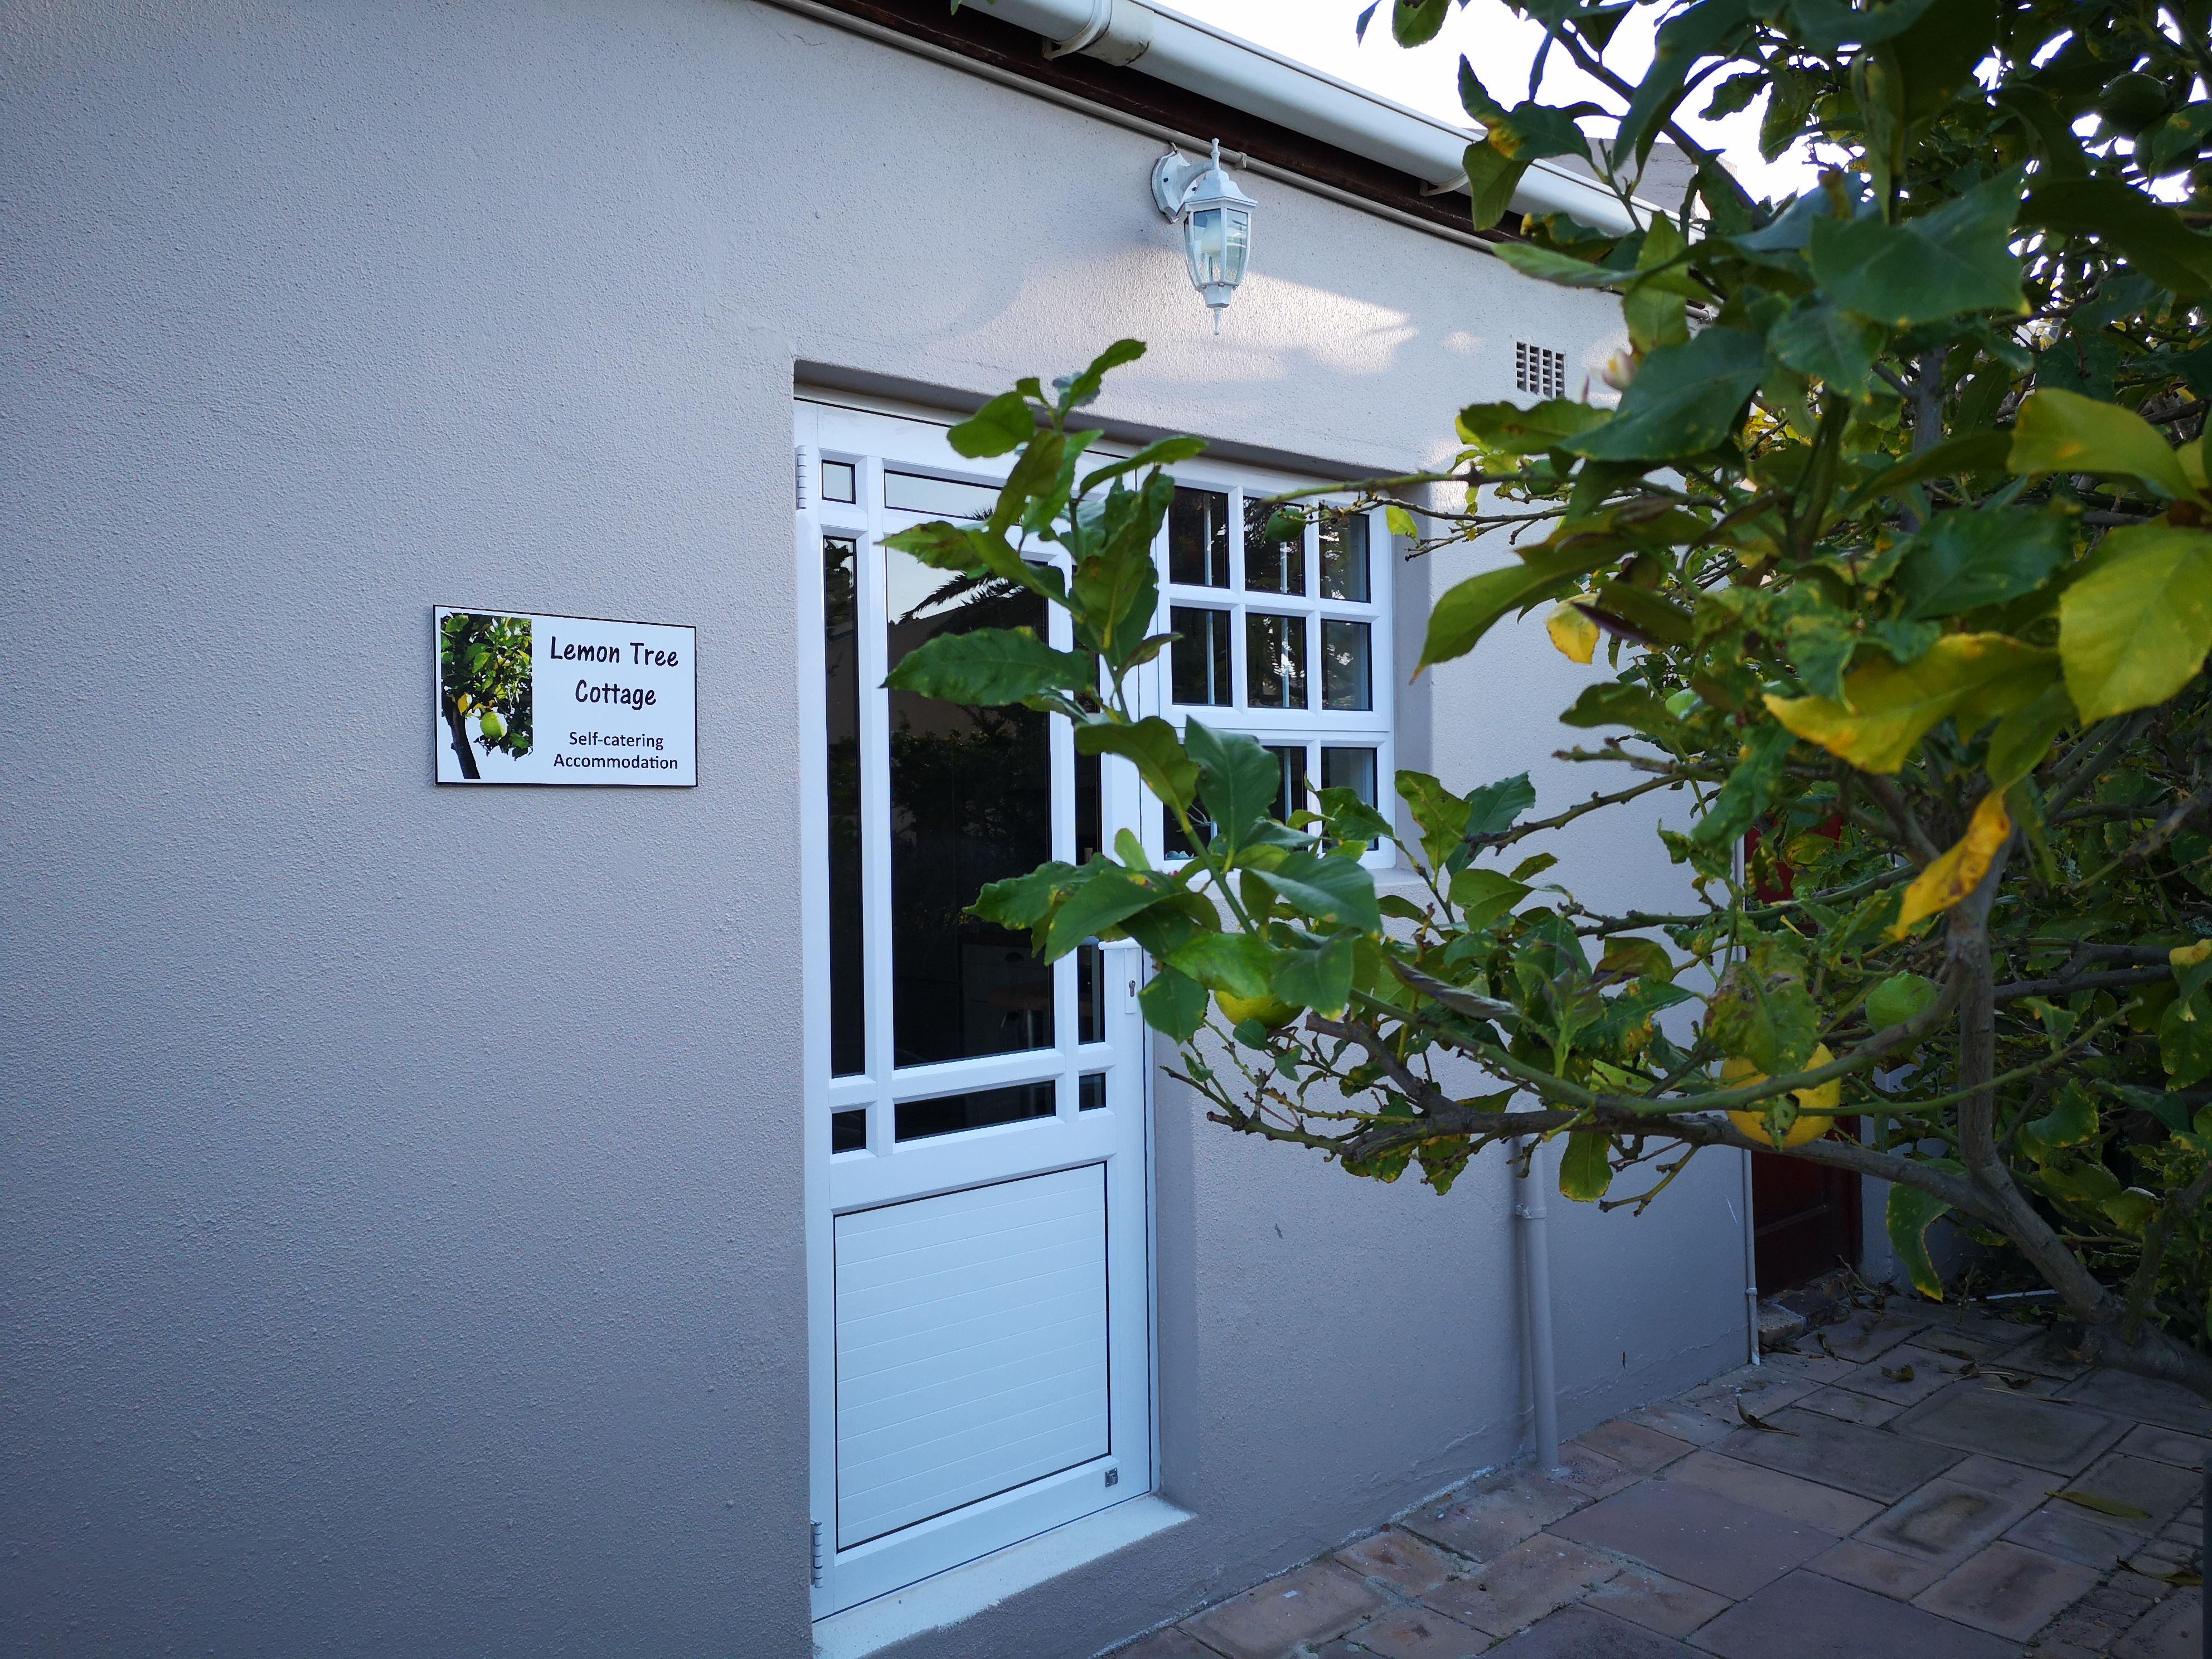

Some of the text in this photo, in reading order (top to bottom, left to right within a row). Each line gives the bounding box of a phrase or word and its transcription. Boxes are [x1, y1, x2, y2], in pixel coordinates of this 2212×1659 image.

[550, 636, 679, 668] Lemon Tree
[575, 679, 657, 711] Cottage
[569, 731, 664, 751] Self-catering
[552, 753, 678, 770] Accommodation
